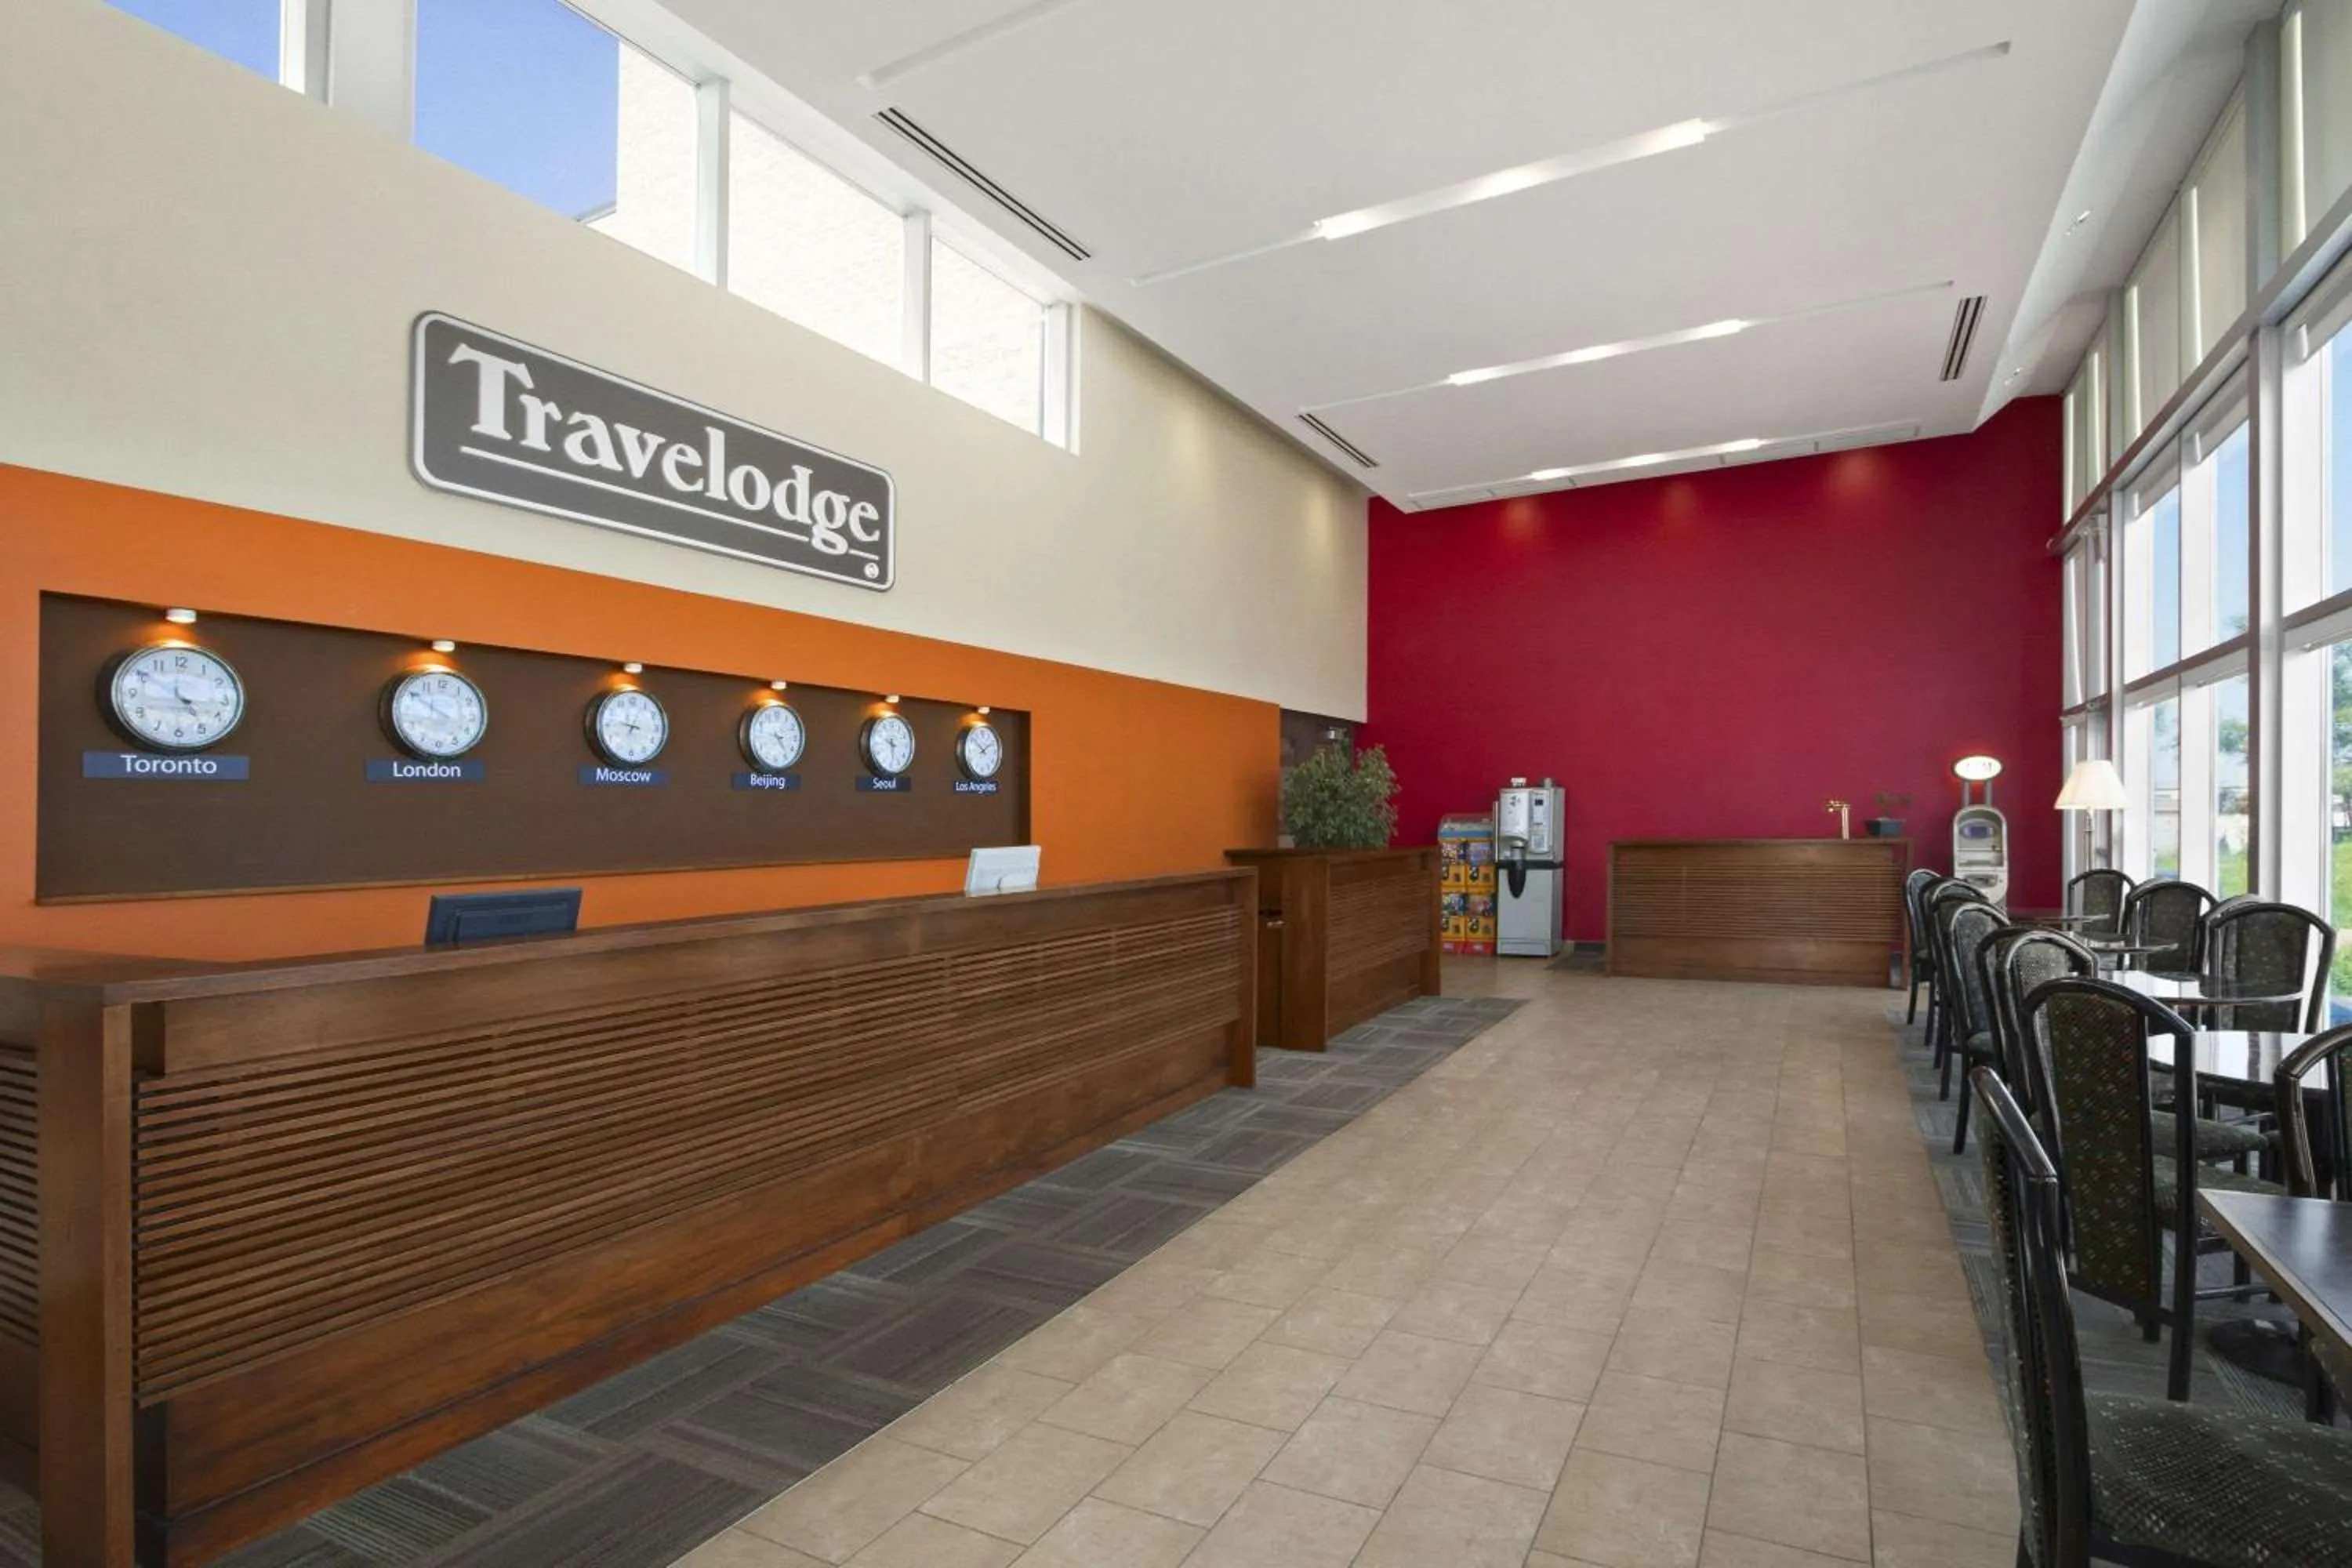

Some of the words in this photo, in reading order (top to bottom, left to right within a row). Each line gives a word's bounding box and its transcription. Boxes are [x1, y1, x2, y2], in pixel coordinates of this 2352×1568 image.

[448, 343, 880, 555] Travelodge
[153, 659, 164, 672] 11
[175, 655, 188, 668] 12
[173, 728, 184, 738] 6
[120, 754, 218, 775] Toronto
[393, 761, 462, 778] London
[596, 767, 652, 782] Moscow
[750, 773, 786, 789] Beijing
[873, 777, 896, 789] Seoul
[956, 781, 968, 791] Los
[968, 781, 996, 794] Angeles
